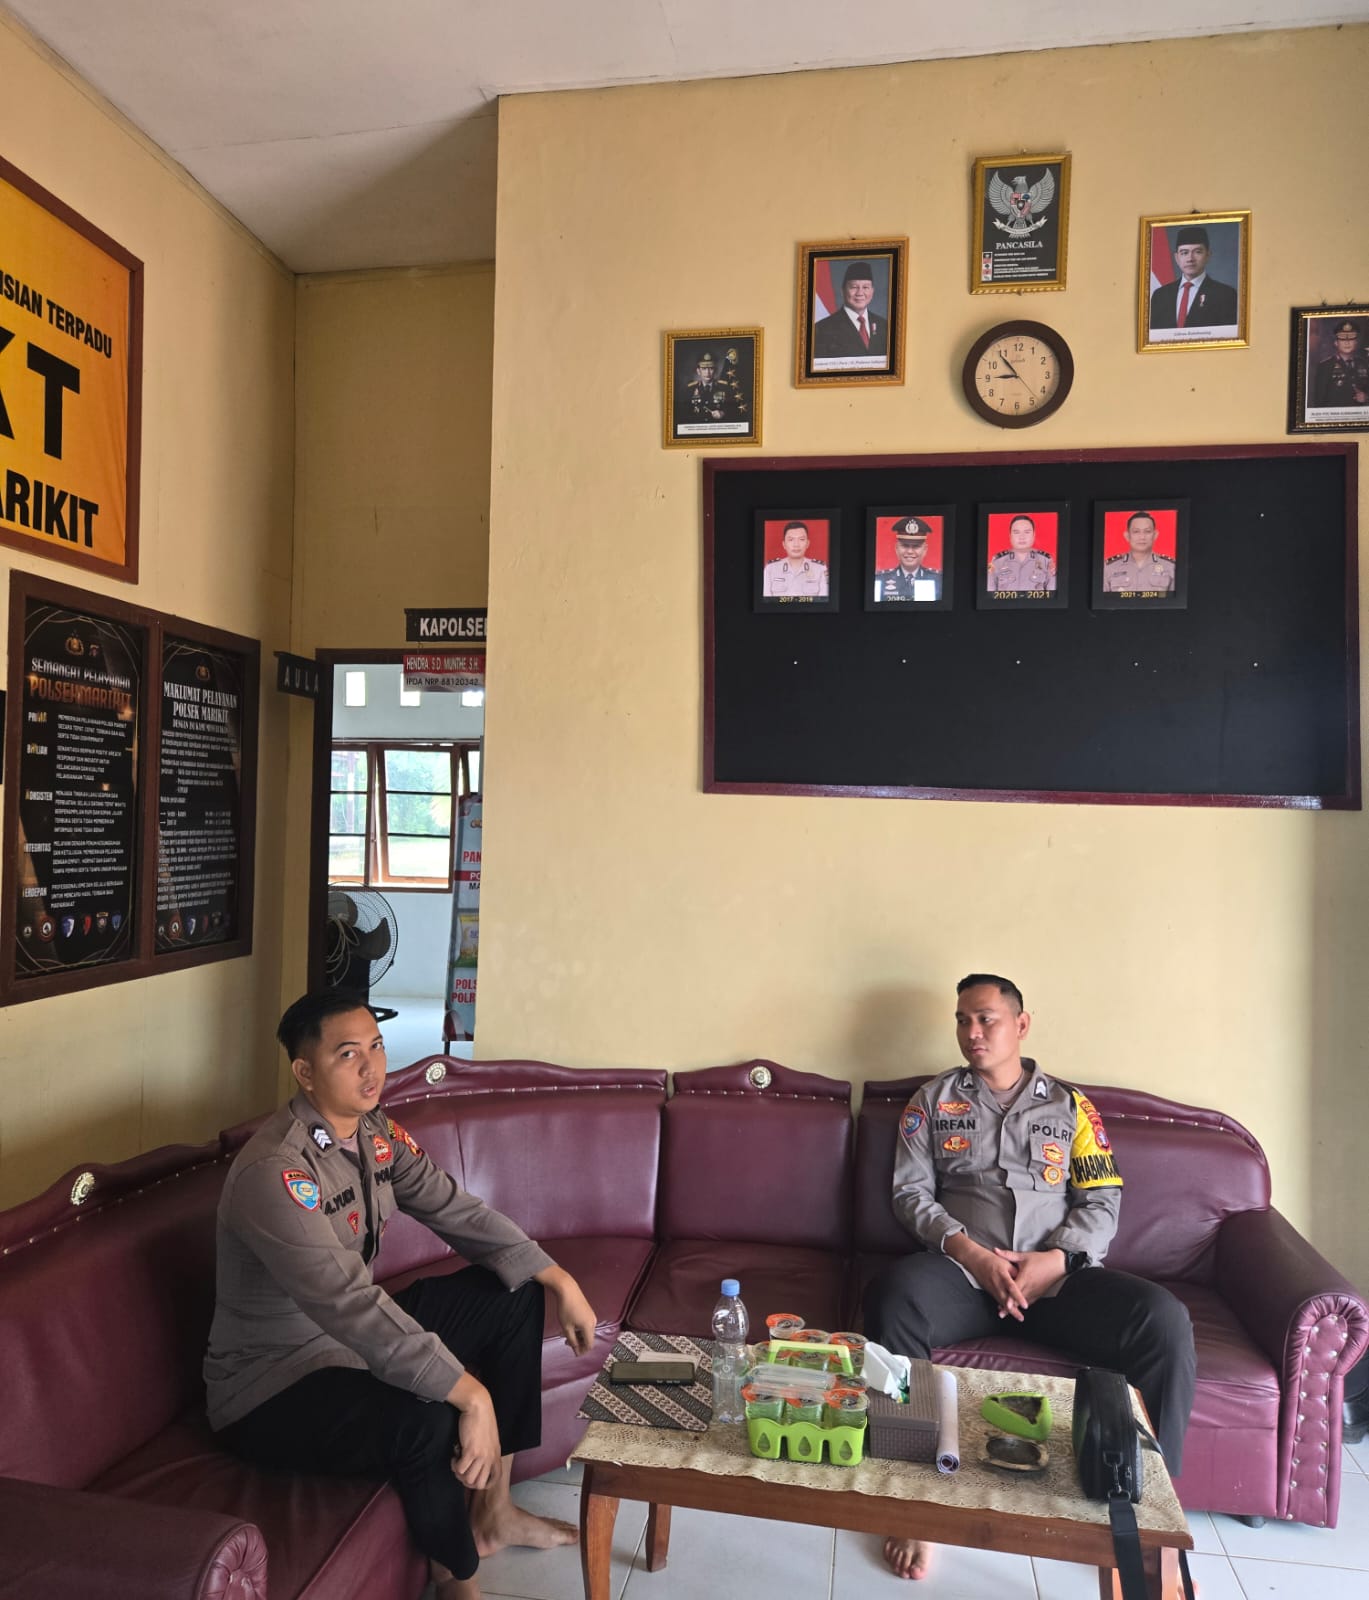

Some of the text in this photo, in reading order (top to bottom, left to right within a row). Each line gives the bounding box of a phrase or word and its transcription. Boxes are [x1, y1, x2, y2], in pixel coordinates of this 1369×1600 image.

[996, 240, 1043, 250] PANCASILA
[47, 299, 112, 359] TERPADU
[0, 468, 99, 549] RIKIT
[994, 591, 1017, 599] 2020
[1027, 591, 1050, 599] 2021
[163, 681, 238, 709] MAKLUMAT PELAYANAN
[173, 701, 200, 719] POLSEK
[935, 1119, 976, 1131] IRFAN
[1032, 1124, 1072, 1143] POLRI
